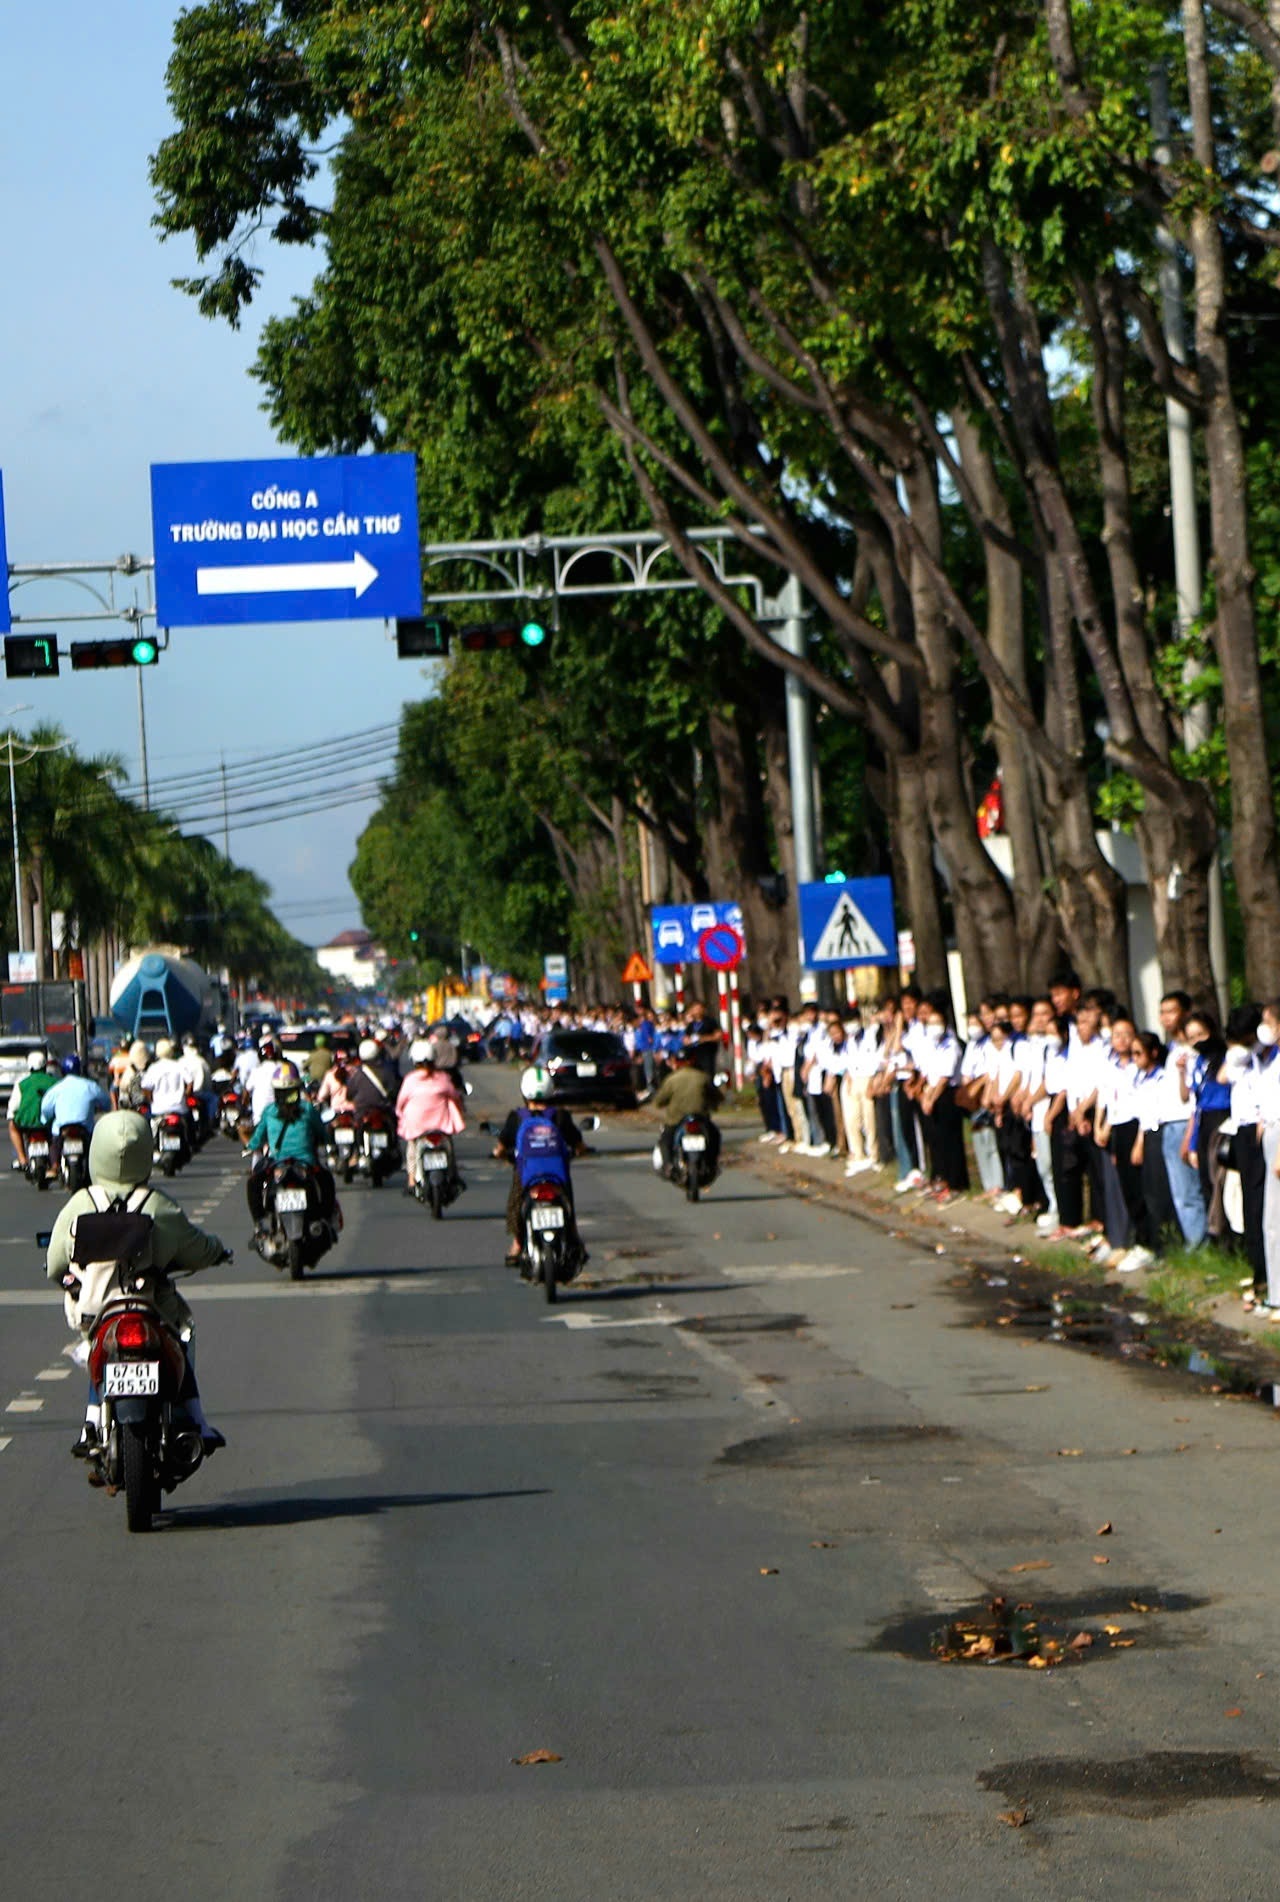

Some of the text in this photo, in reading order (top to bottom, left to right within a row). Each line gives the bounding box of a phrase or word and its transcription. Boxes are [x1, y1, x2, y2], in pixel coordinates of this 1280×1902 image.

[305, 490, 318, 509] A
[170, 519, 242, 543] TRƯỜNG
[246, 520, 277, 543] ĐẠI
[281, 518, 319, 541] HỌC
[364, 512, 401, 535] THƠ
